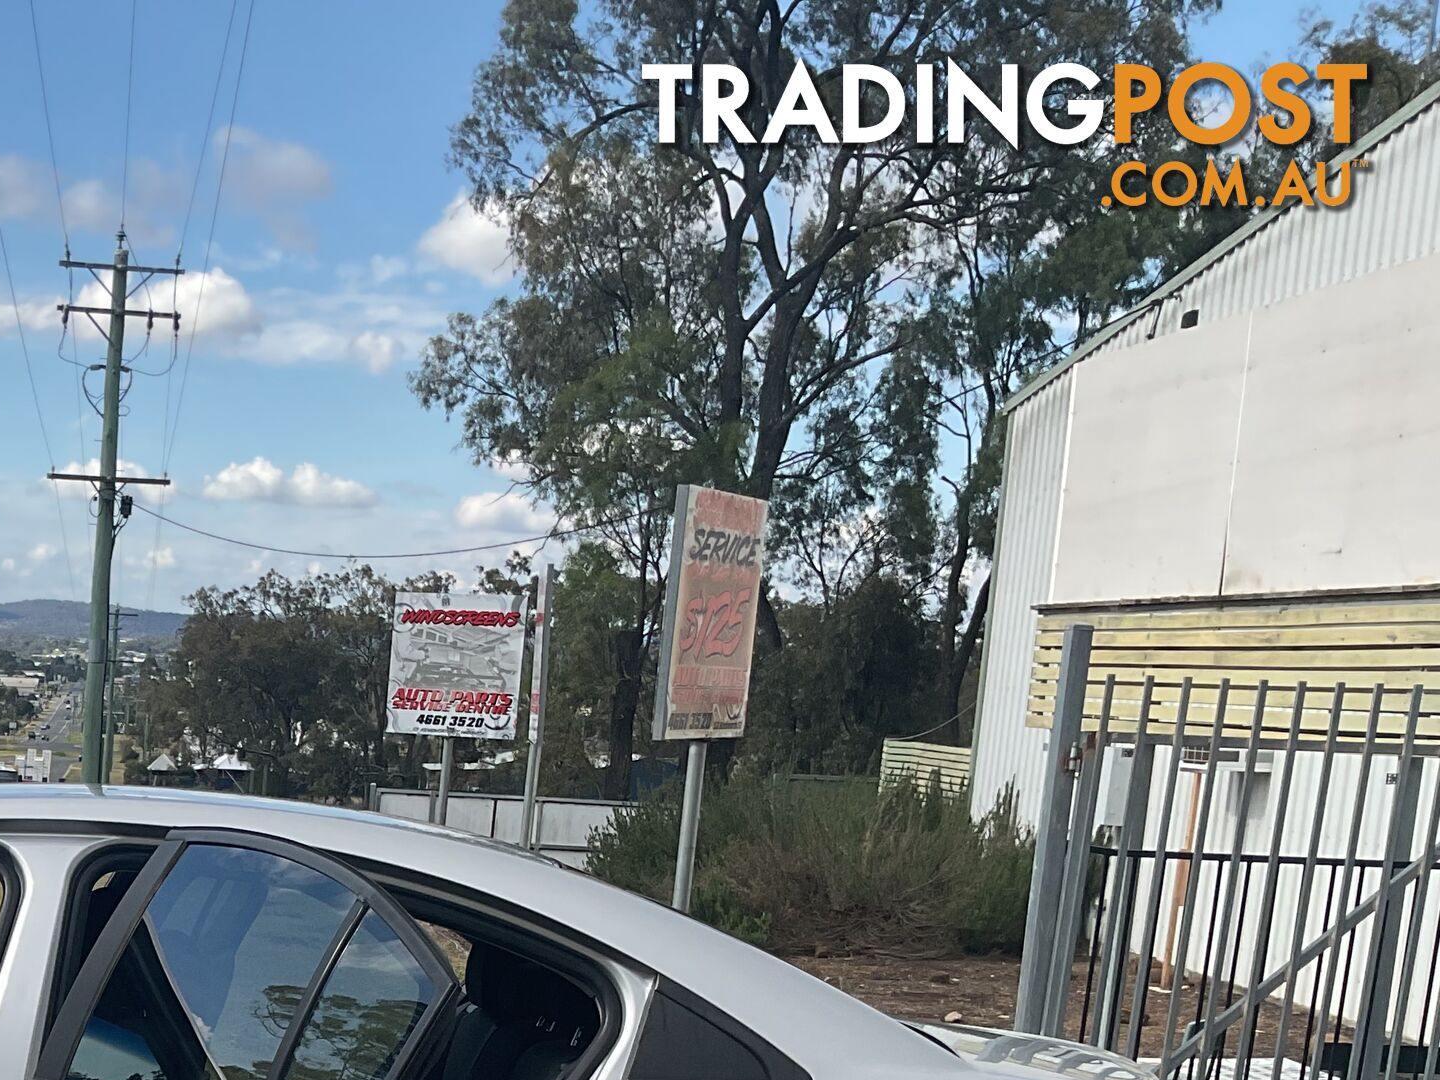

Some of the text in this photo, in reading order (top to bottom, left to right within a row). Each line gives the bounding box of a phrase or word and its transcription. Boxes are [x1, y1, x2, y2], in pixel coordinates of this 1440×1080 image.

[689, 528, 761, 567] SERVICE
[401, 609, 522, 628] WINDSCREENS
[391, 688, 515, 706] AUTO PARTS
[391, 700, 512, 716] SERVICE CENTRE
[416, 714, 485, 728] 4661 3520
